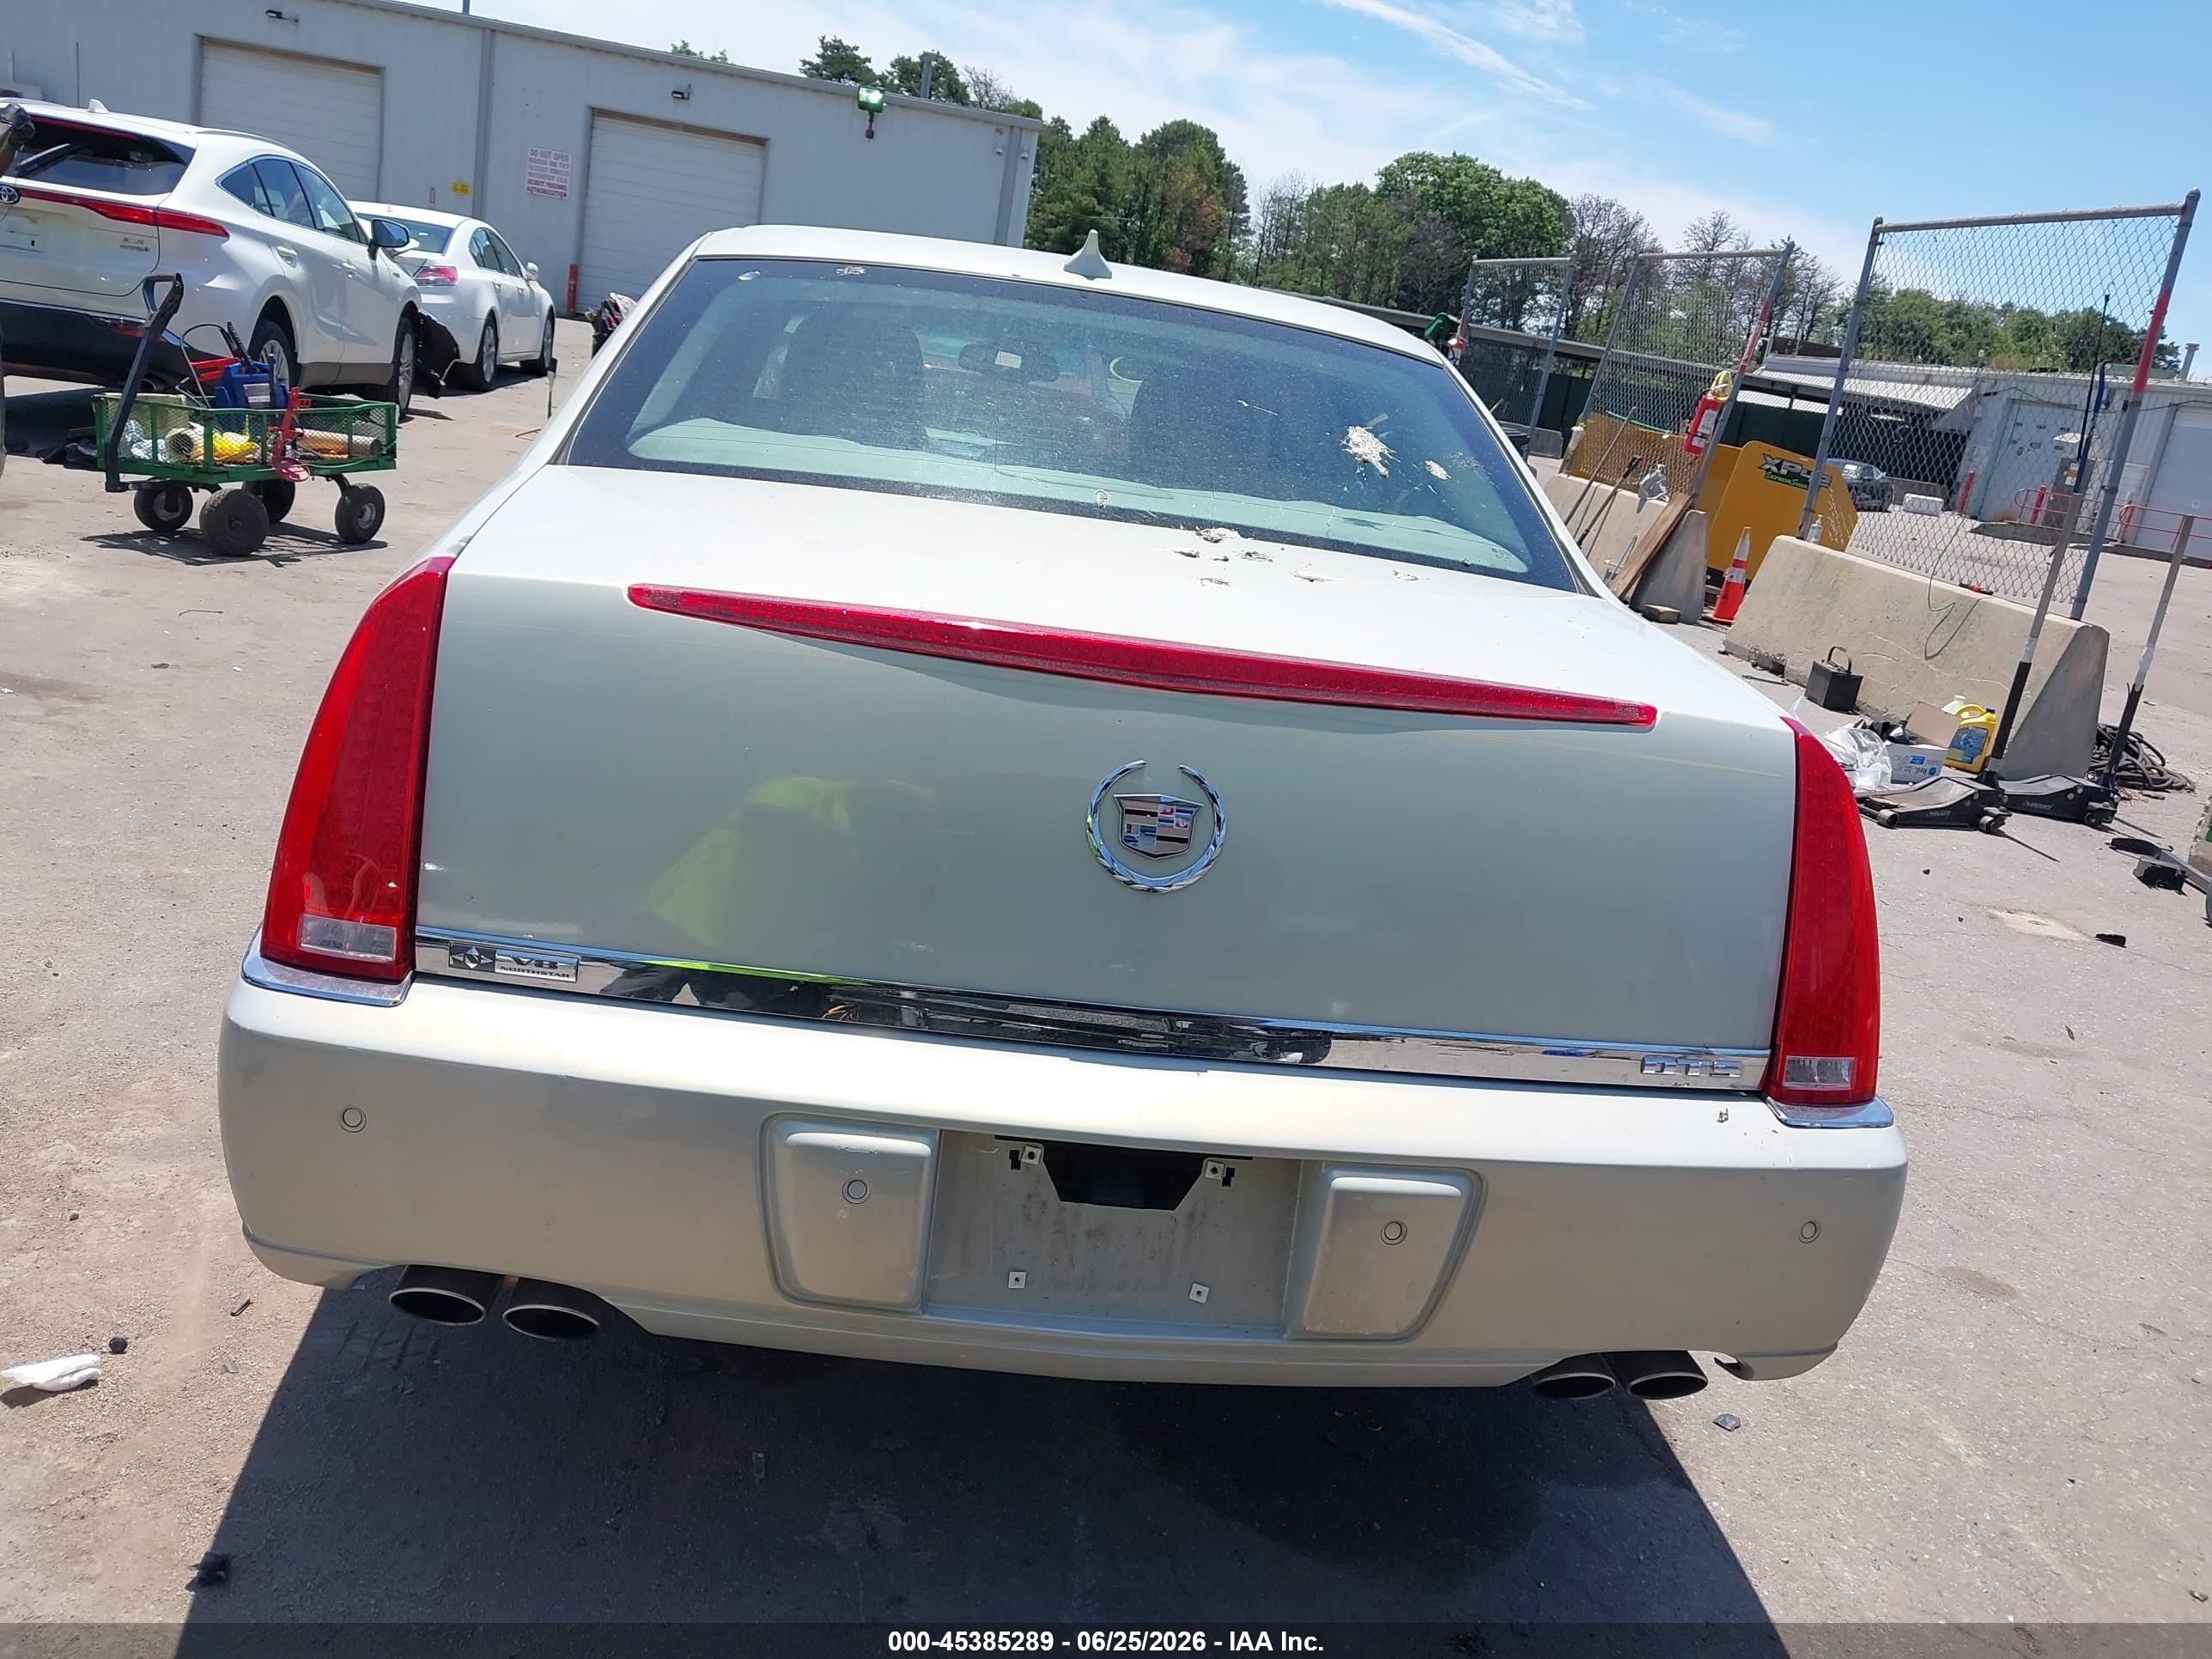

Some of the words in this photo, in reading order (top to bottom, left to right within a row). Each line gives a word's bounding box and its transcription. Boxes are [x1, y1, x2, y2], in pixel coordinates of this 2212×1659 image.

[511, 954, 558, 969] V8
[500, 965, 570, 978] NORTHSTAR
[1640, 1054, 1744, 1078] DTS
